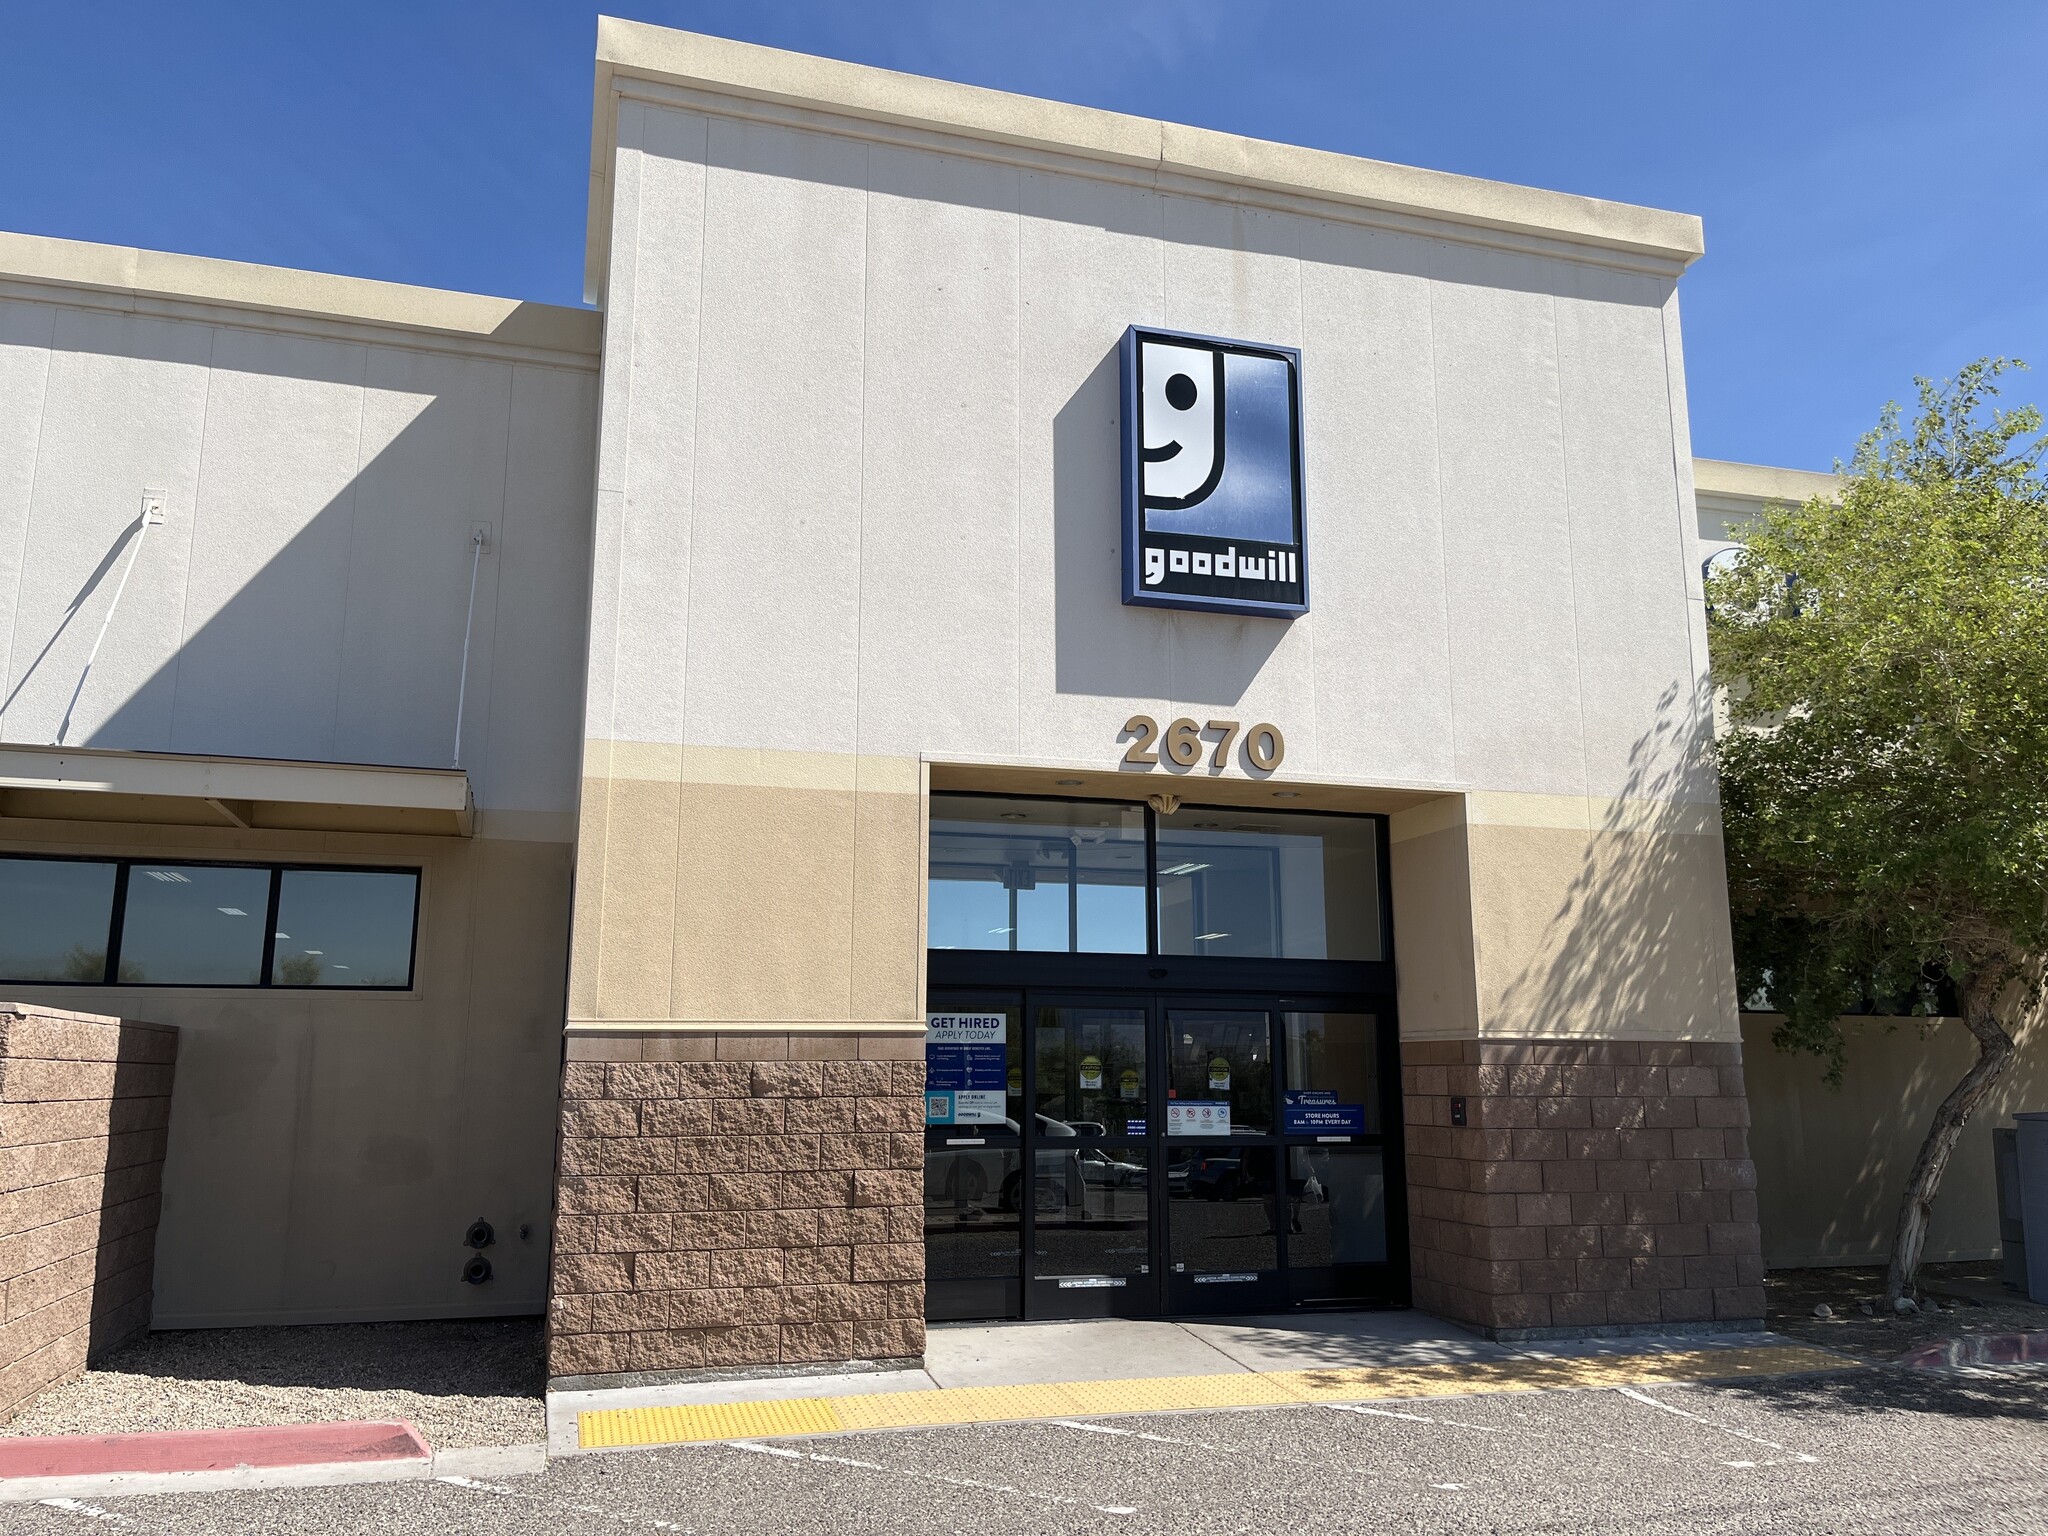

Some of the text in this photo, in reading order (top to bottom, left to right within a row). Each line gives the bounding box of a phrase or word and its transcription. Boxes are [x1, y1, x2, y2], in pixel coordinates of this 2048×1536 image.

[1145, 547, 1297, 585] goodwill
[1124, 714, 1285, 772] 2670
[930, 1017, 1000, 1029] GET HIRED
[934, 1030, 997, 1040] APPLY TODAY
[1297, 1094, 1337, 1105] Treasures
